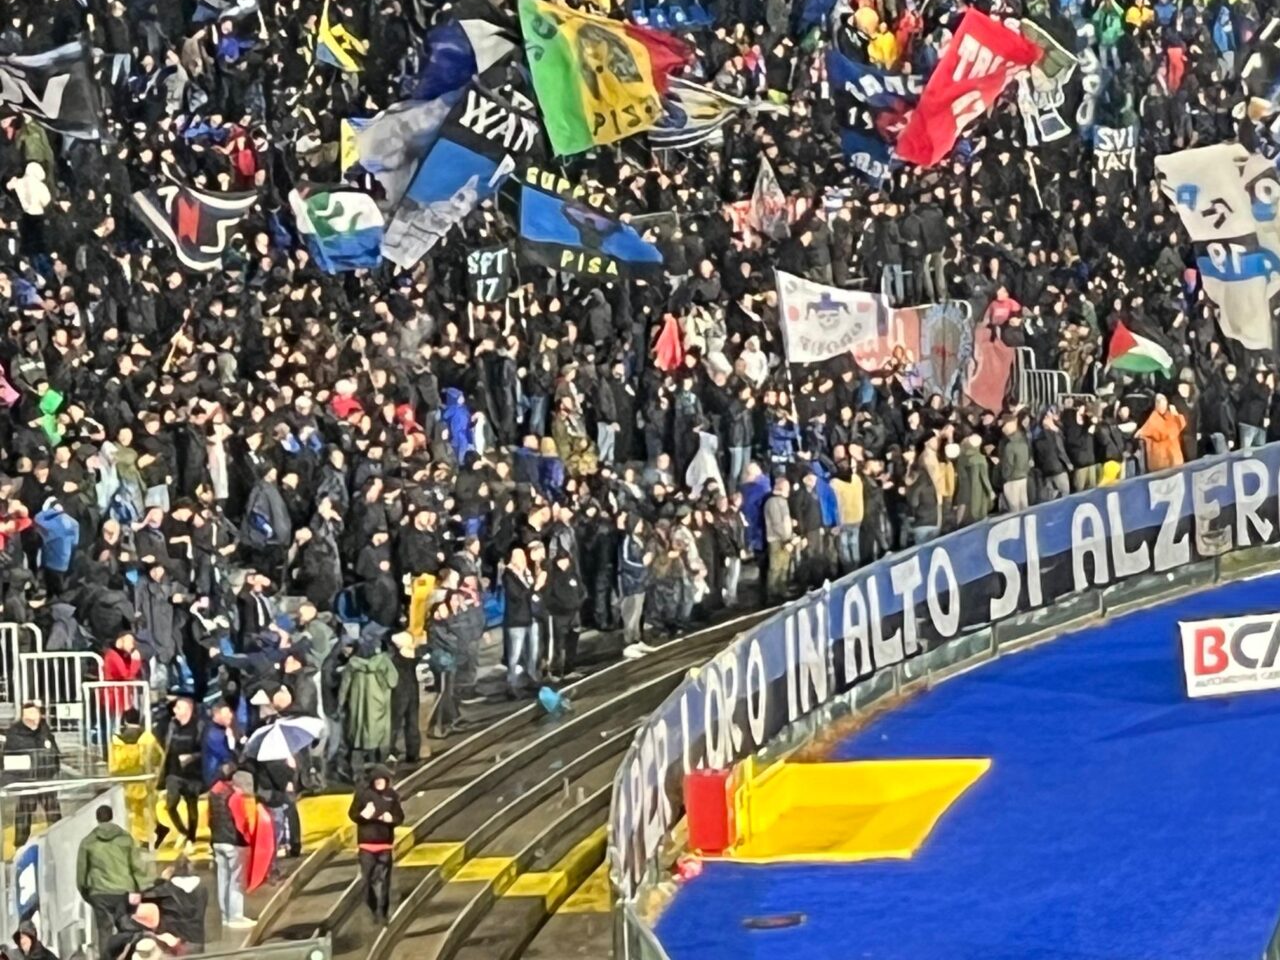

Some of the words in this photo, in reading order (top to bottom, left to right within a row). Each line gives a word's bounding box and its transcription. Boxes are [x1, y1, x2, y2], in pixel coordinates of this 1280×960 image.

[560, 249, 619, 276] PISA
[476, 277, 500, 302] 17
[784, 601, 829, 723] IN
[843, 546, 960, 684] ALTO
[986, 514, 1044, 621] SI
